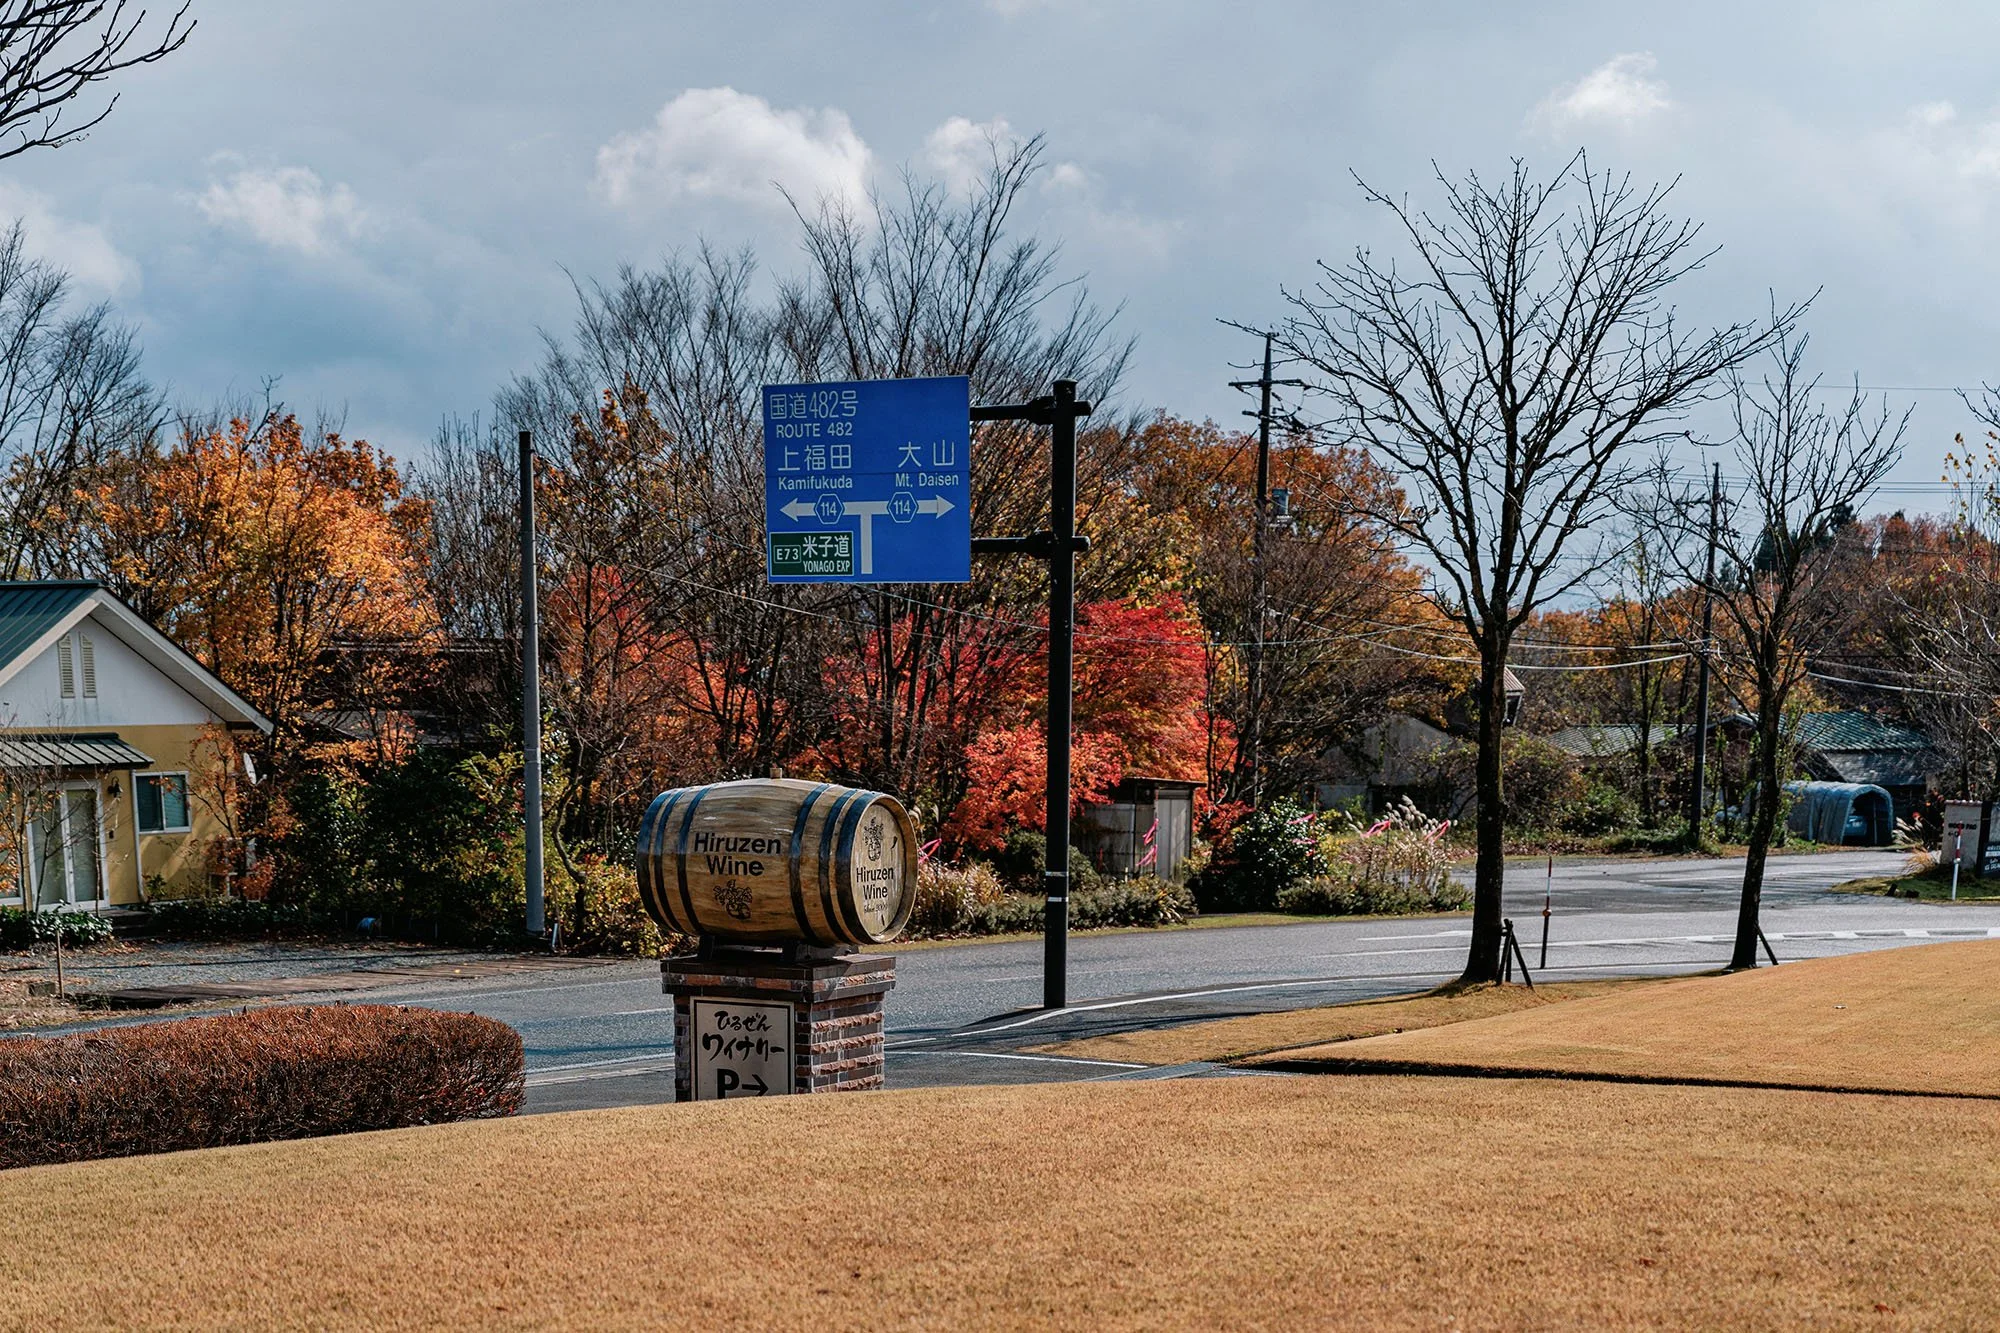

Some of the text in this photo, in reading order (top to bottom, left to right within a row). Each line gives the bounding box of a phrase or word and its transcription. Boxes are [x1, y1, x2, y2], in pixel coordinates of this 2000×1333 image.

[770, 390, 859, 419] 国道482号
[776, 422, 853, 438] ROUTE 482
[777, 444, 852, 471] 上福田
[898, 440, 955, 468] 大山
[778, 475, 853, 490] Kamifukuda
[895, 472, 959, 488] Mt. Daisen
[820, 501, 837, 516] 114
[893, 500, 911, 515] 114
[776, 548, 799, 560] E73
[802, 535, 850, 558] 米子道
[803, 560, 850, 573] YONAGO EXP
[694, 832, 782, 855] Hiruzen
[705, 855, 765, 877] Wine
[856, 866, 894, 883] Hiruzen
[863, 884, 888, 900] Wine
[714, 1011, 772, 1032] ひるぜん
[702, 1032, 785, 1062] ワイナリー
[717, 1068, 740, 1098] P
